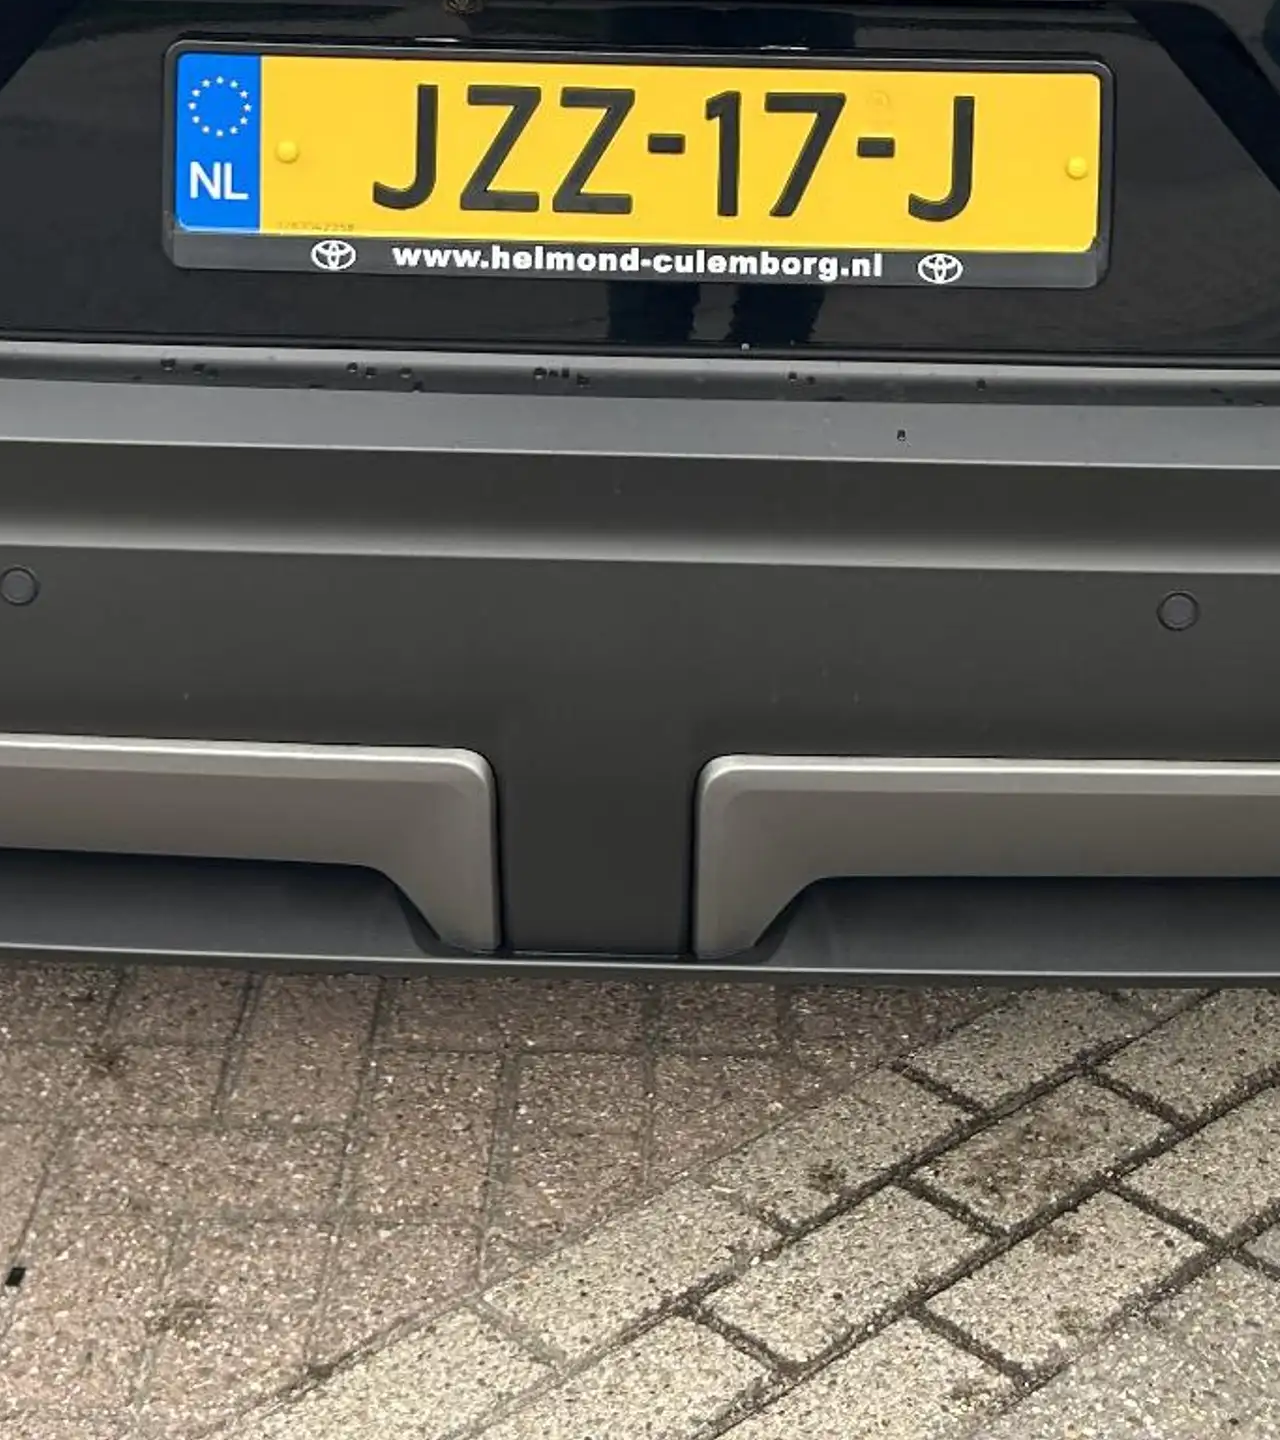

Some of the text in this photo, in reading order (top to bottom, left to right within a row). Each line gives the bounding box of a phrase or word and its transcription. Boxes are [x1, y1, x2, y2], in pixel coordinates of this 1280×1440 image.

[372, 83, 976, 222] JZZ-17-J
[189, 160, 250, 201] NL
[392, 244, 883, 281] www.helmond-culemborg.nl
